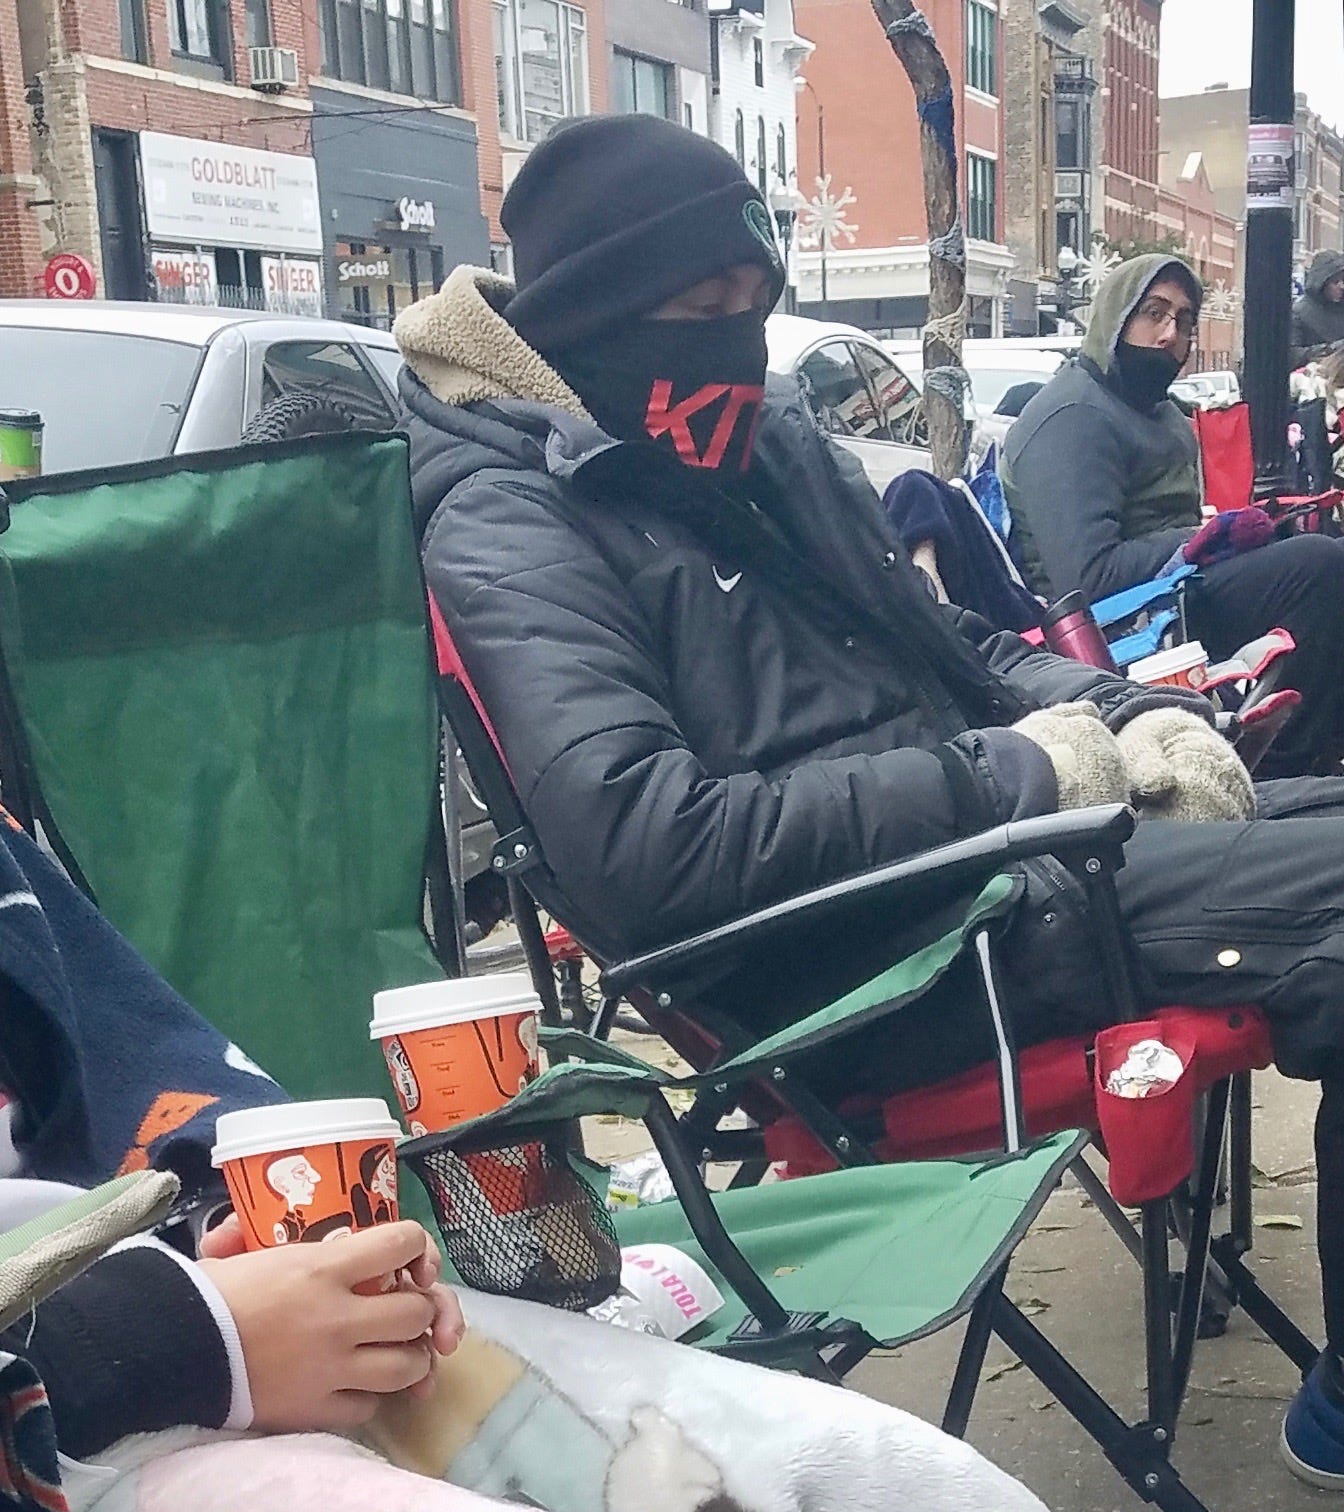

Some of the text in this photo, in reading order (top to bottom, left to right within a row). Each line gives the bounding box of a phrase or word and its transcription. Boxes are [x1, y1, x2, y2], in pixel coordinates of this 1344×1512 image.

[191, 156, 276, 191] GOLDBLATT
[155, 260, 211, 288] SINGER
[268, 265, 316, 293] SINGER
[338, 260, 390, 281] Schott
